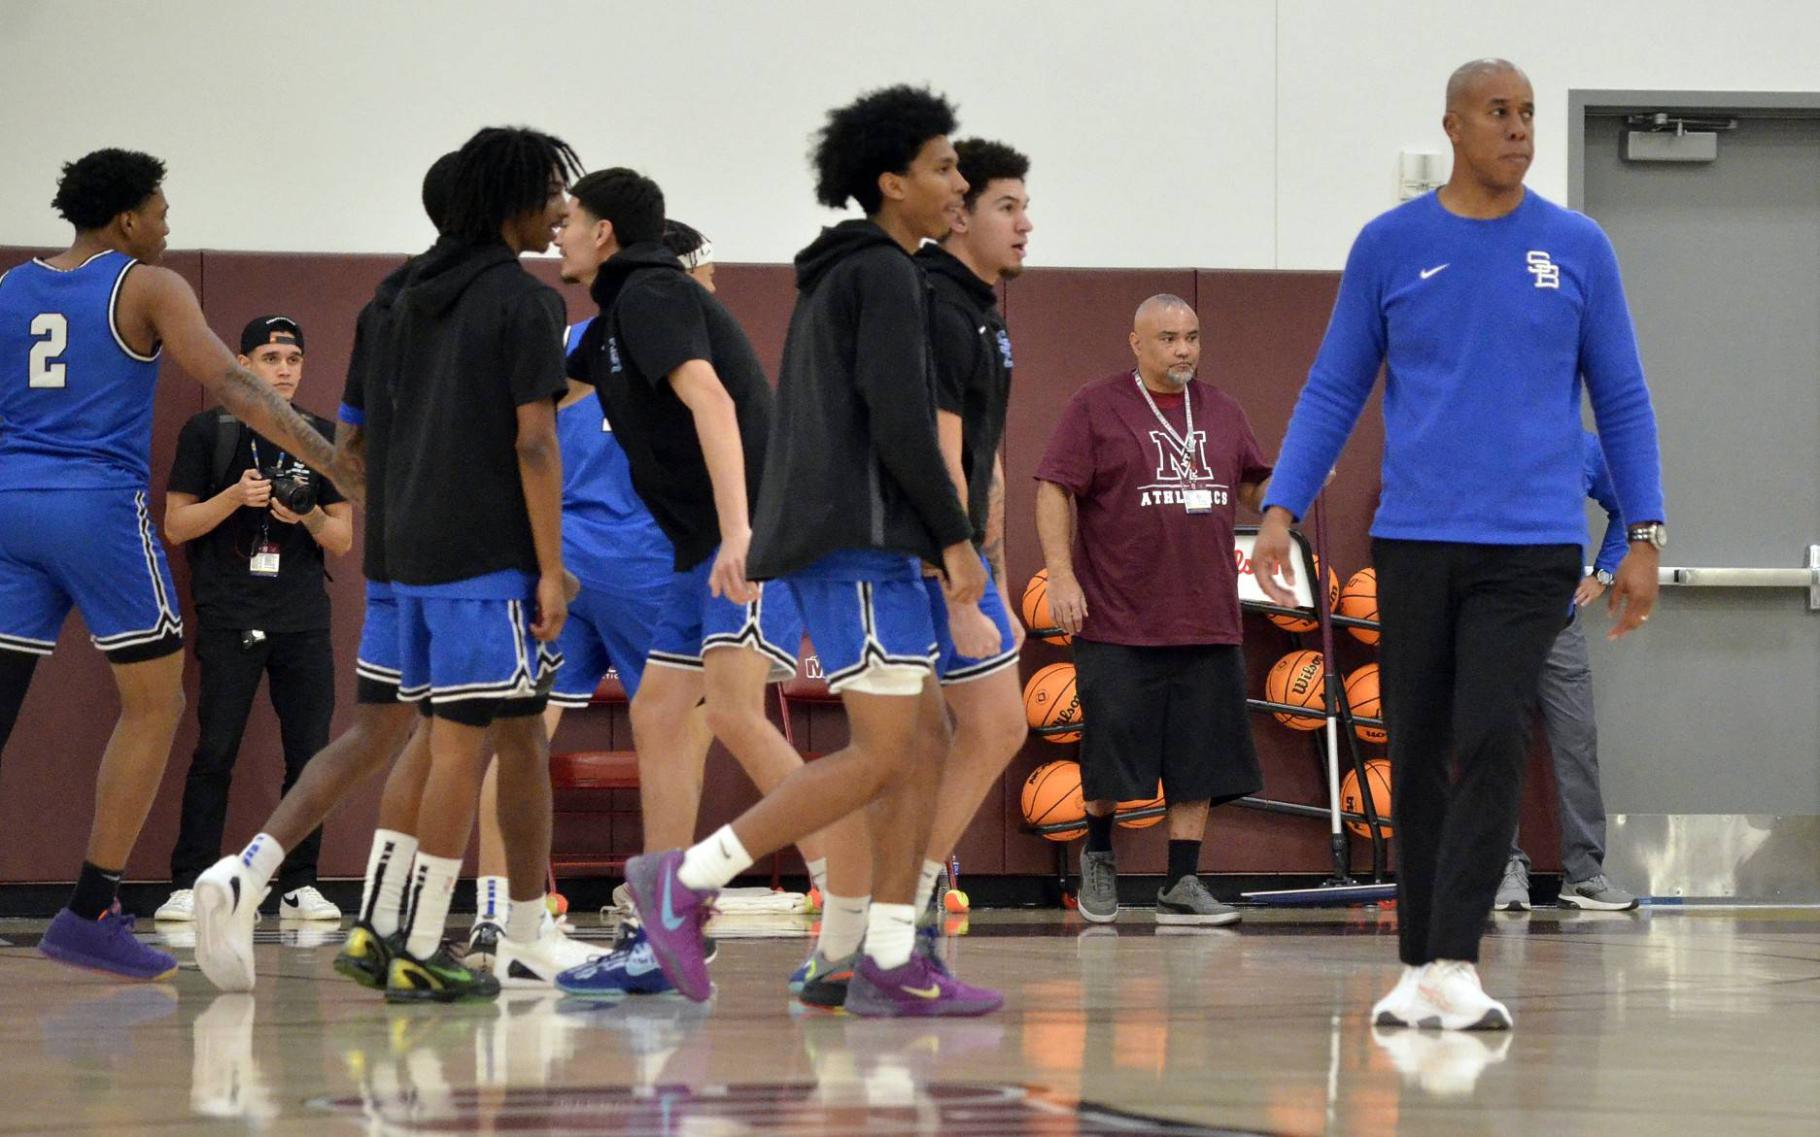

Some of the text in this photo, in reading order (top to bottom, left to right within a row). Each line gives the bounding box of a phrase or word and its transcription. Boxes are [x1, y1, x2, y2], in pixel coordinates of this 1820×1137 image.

[1526, 250, 1559, 289] SB
[28, 311, 68, 389] 2
[1148, 430, 1214, 480] M
[1140, 489, 1229, 507] ATHLCS
[1052, 694, 1080, 726] ilso
